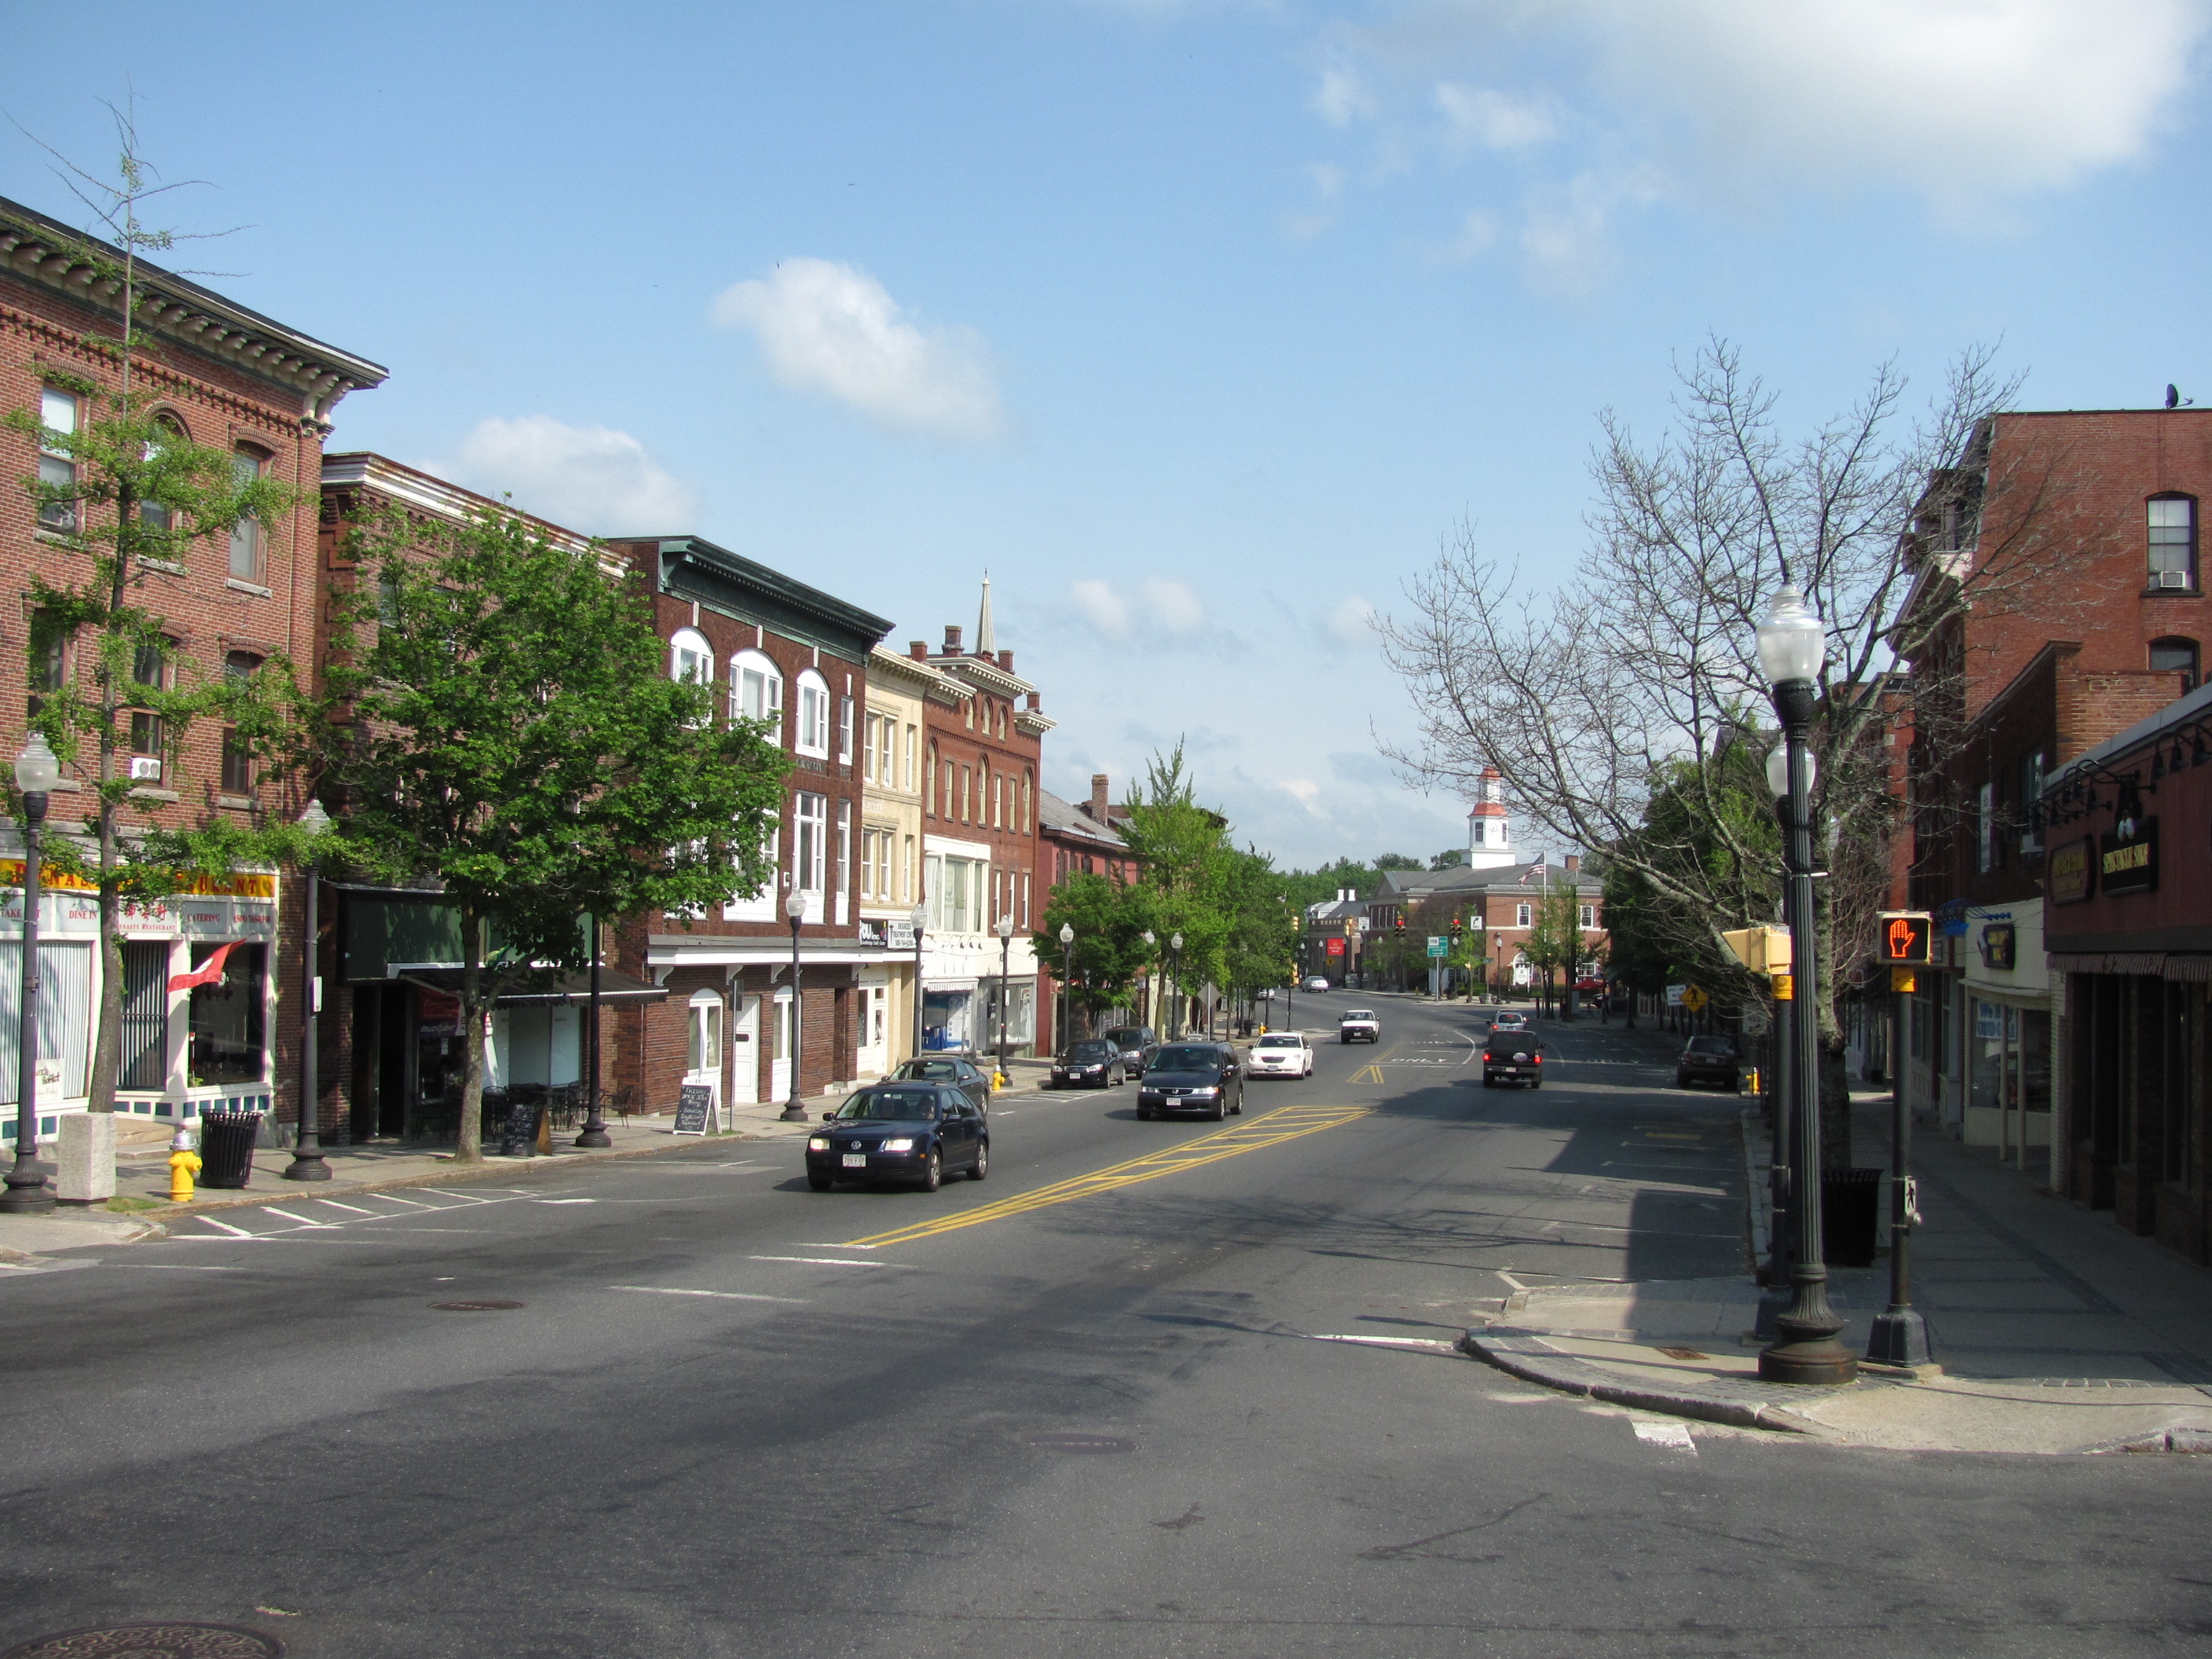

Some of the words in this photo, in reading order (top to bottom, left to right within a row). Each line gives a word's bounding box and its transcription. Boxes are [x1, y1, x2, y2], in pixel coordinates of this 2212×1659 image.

[1, 908, 22, 917] TAKE
[69, 910, 87, 919] DINE
[89, 910, 98, 919] IN
[187, 914, 220, 922] CATERING
